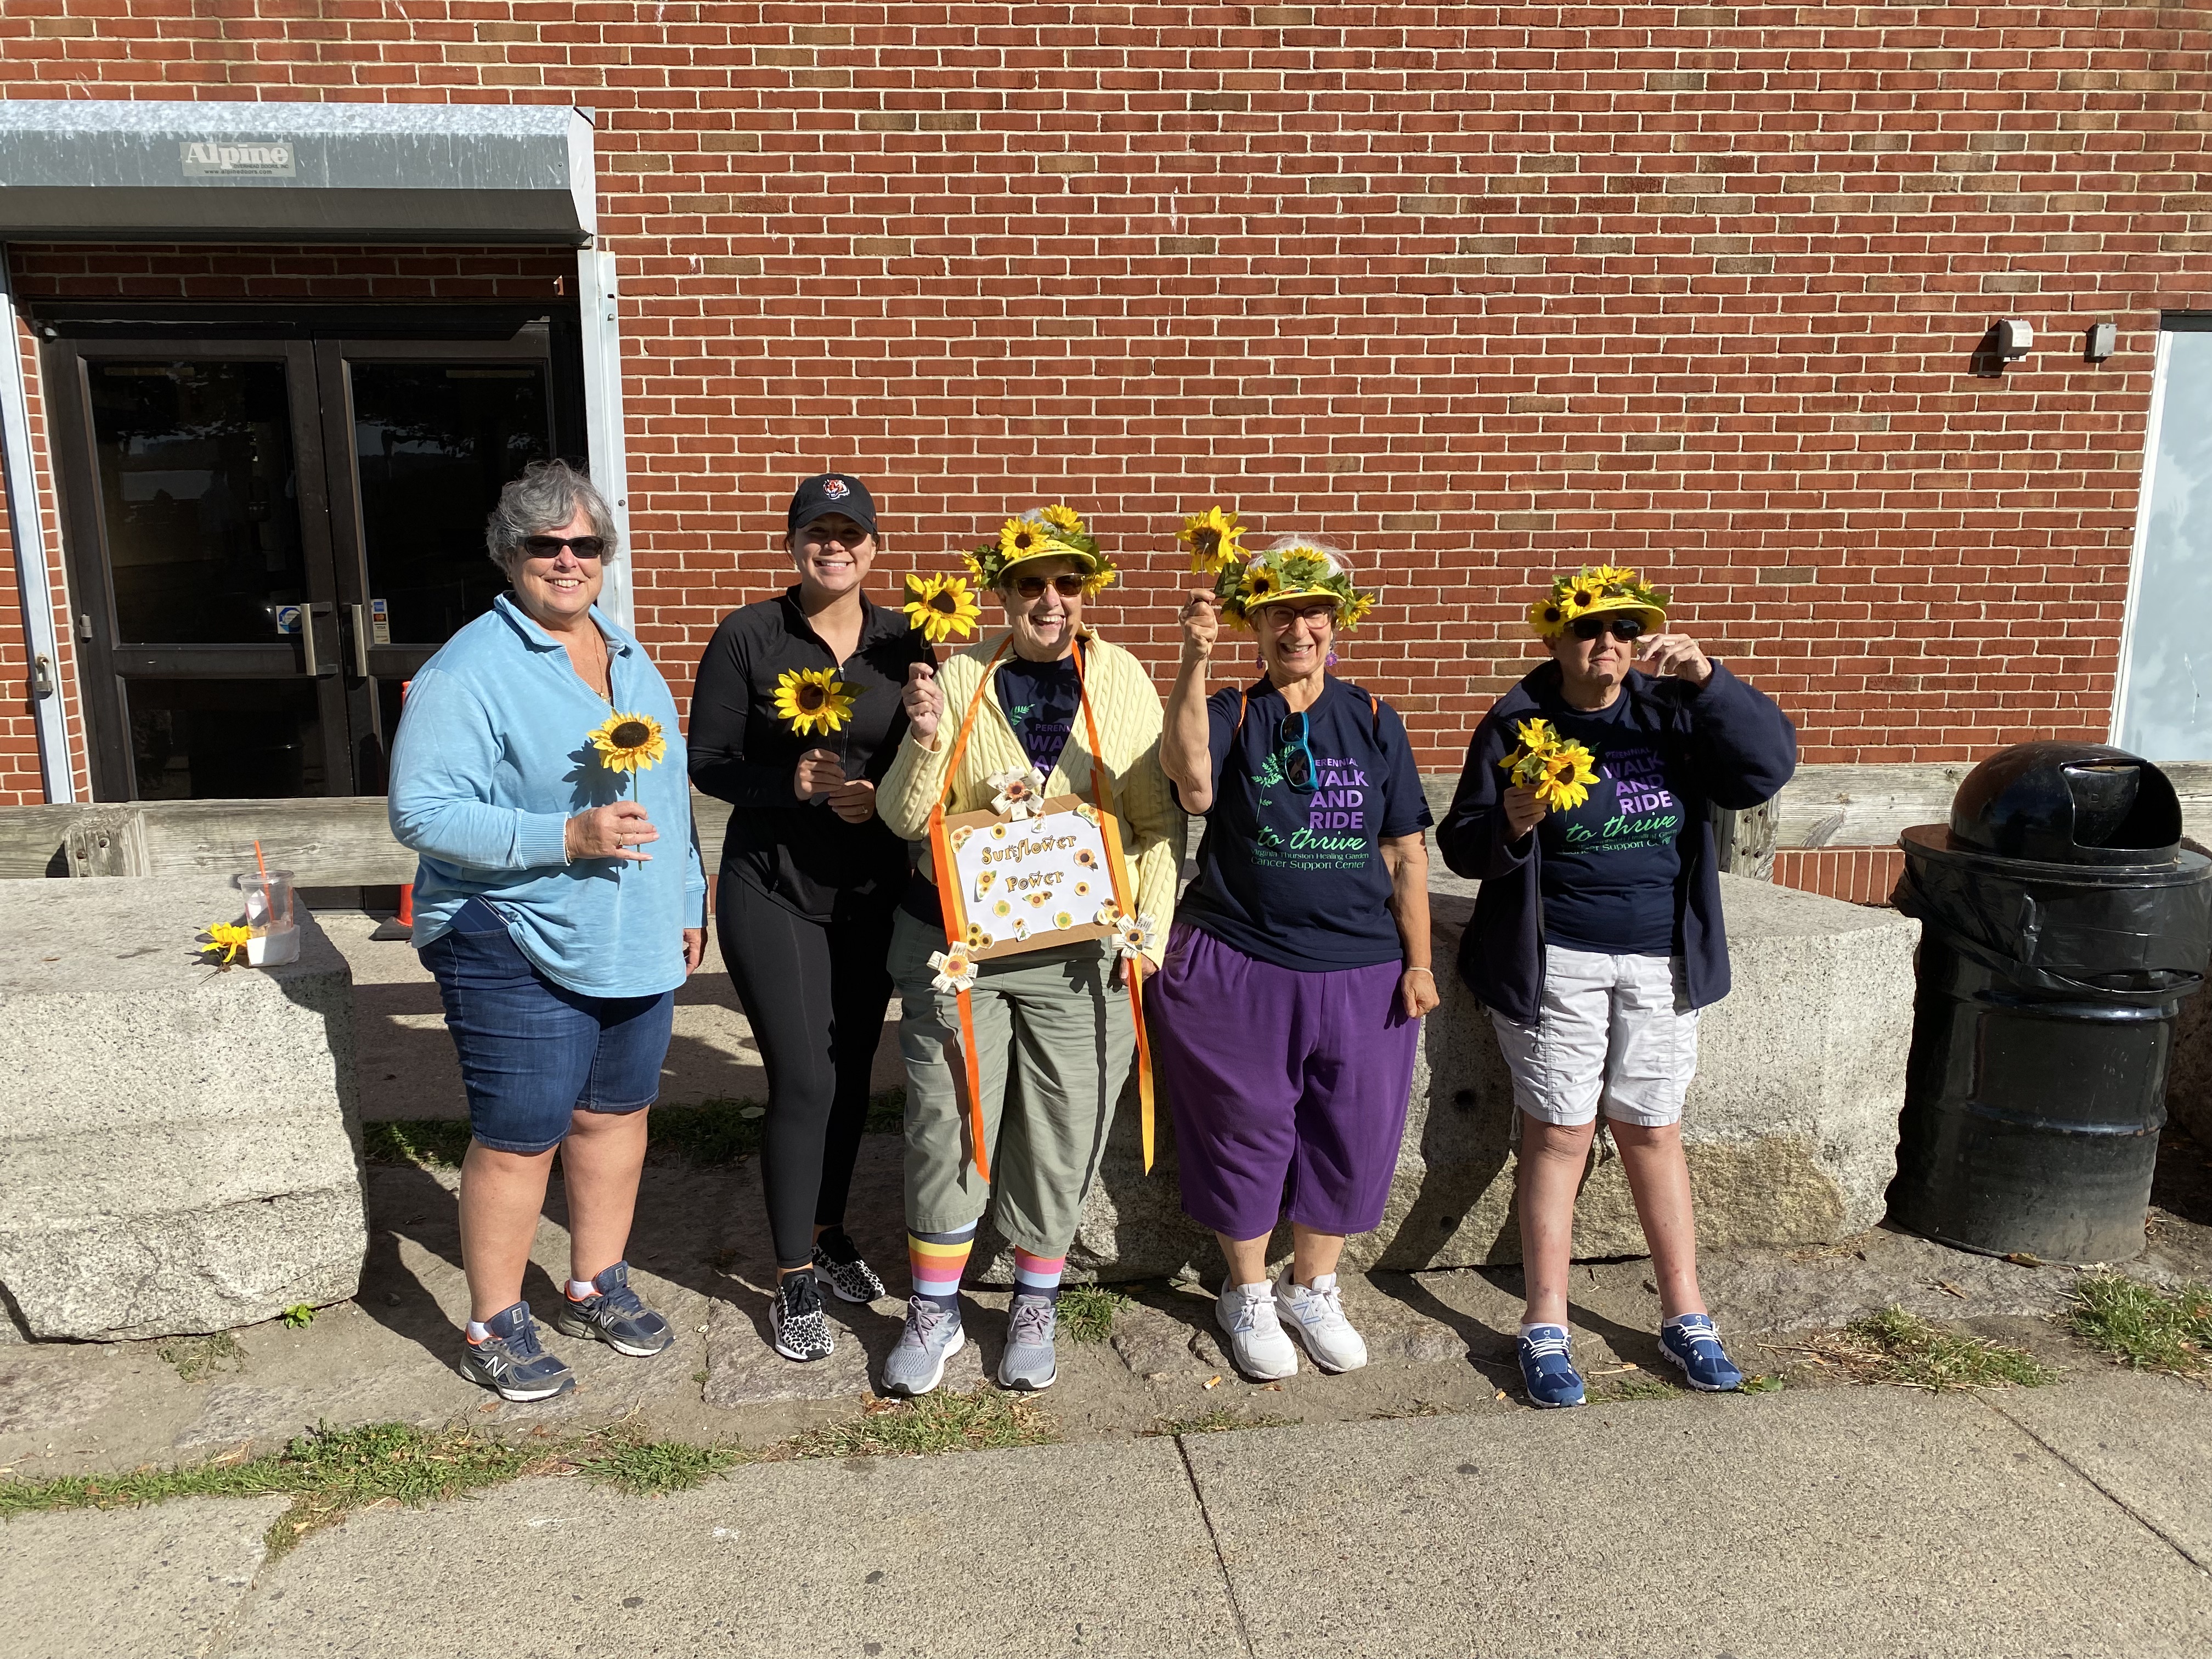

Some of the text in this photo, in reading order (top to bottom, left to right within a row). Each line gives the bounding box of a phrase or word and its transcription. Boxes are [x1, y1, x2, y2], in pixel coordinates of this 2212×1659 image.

[185, 143, 289, 170] Alpine
[1314, 757, 1359, 767] ERENNIAL
[1602, 752, 1665, 778] WALK
[1615, 774, 1664, 797] AND
[1309, 789, 1364, 808] AND
[1619, 790, 1673, 815] RIDE
[1309, 811, 1364, 830] RIDE
[1566, 823, 1597, 842] to
[1603, 812, 1678, 838] thrive
[1256, 825, 1367, 851] to thrive
[1602, 840, 1644, 851] Support
[981, 835, 1077, 865] Sunflower
[1251, 848, 1278, 857] Virginia
[1280, 851, 1315, 860] Thurston
[1251, 856, 1366, 871] Cancer Support Center
[1005, 870, 1064, 893] Power
[484, 1355, 509, 1378] N
